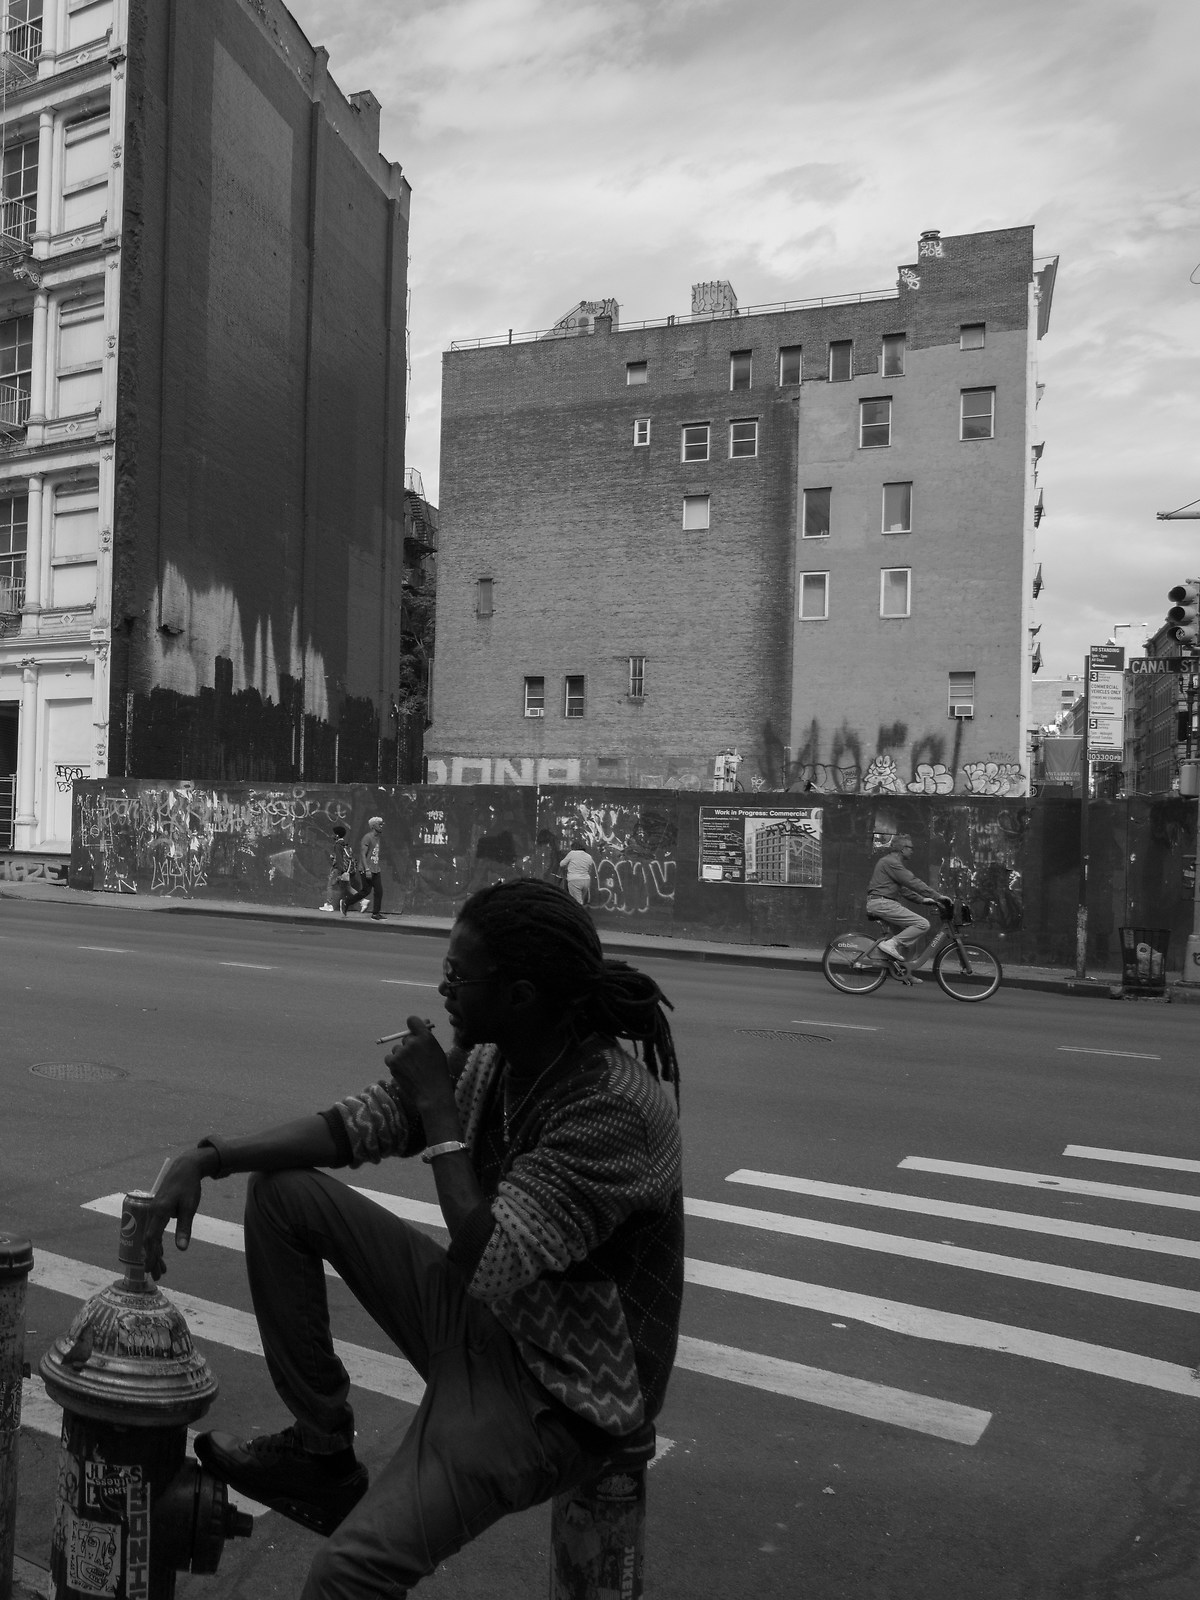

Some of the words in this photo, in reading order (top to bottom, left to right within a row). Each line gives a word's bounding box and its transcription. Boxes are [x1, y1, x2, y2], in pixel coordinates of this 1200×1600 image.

[1132, 660, 1174, 674] CANAL
[1180, 660, 1196, 673] ST
[1091, 672, 1097, 681] 3
[1090, 719, 1097, 728] 5
[714, 808, 730, 816] Work
[738, 809, 768, 817] Progress:
